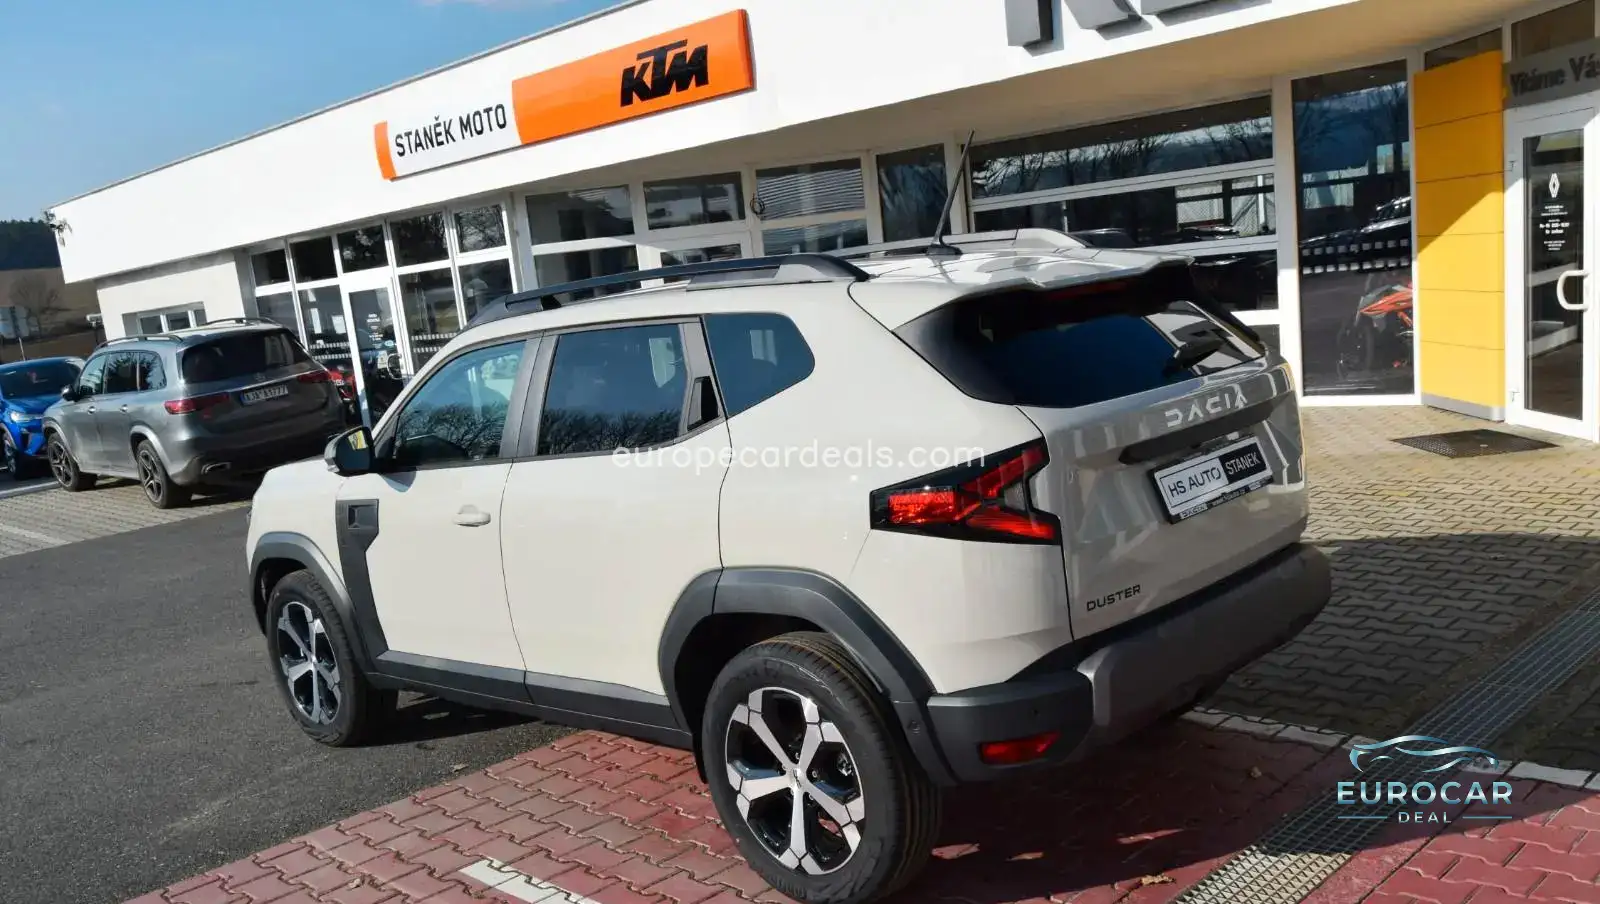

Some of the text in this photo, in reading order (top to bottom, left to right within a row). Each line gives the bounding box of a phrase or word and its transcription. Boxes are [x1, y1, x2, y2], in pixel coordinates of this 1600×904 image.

[620, 39, 709, 107] KTM
[394, 103, 507, 157] STANĚK MOTO
[1164, 391, 1248, 428] DACIA
[1168, 480, 1187, 498] HS
[1188, 466, 1222, 491] AUTO
[1086, 584, 1141, 612] DUSTER
